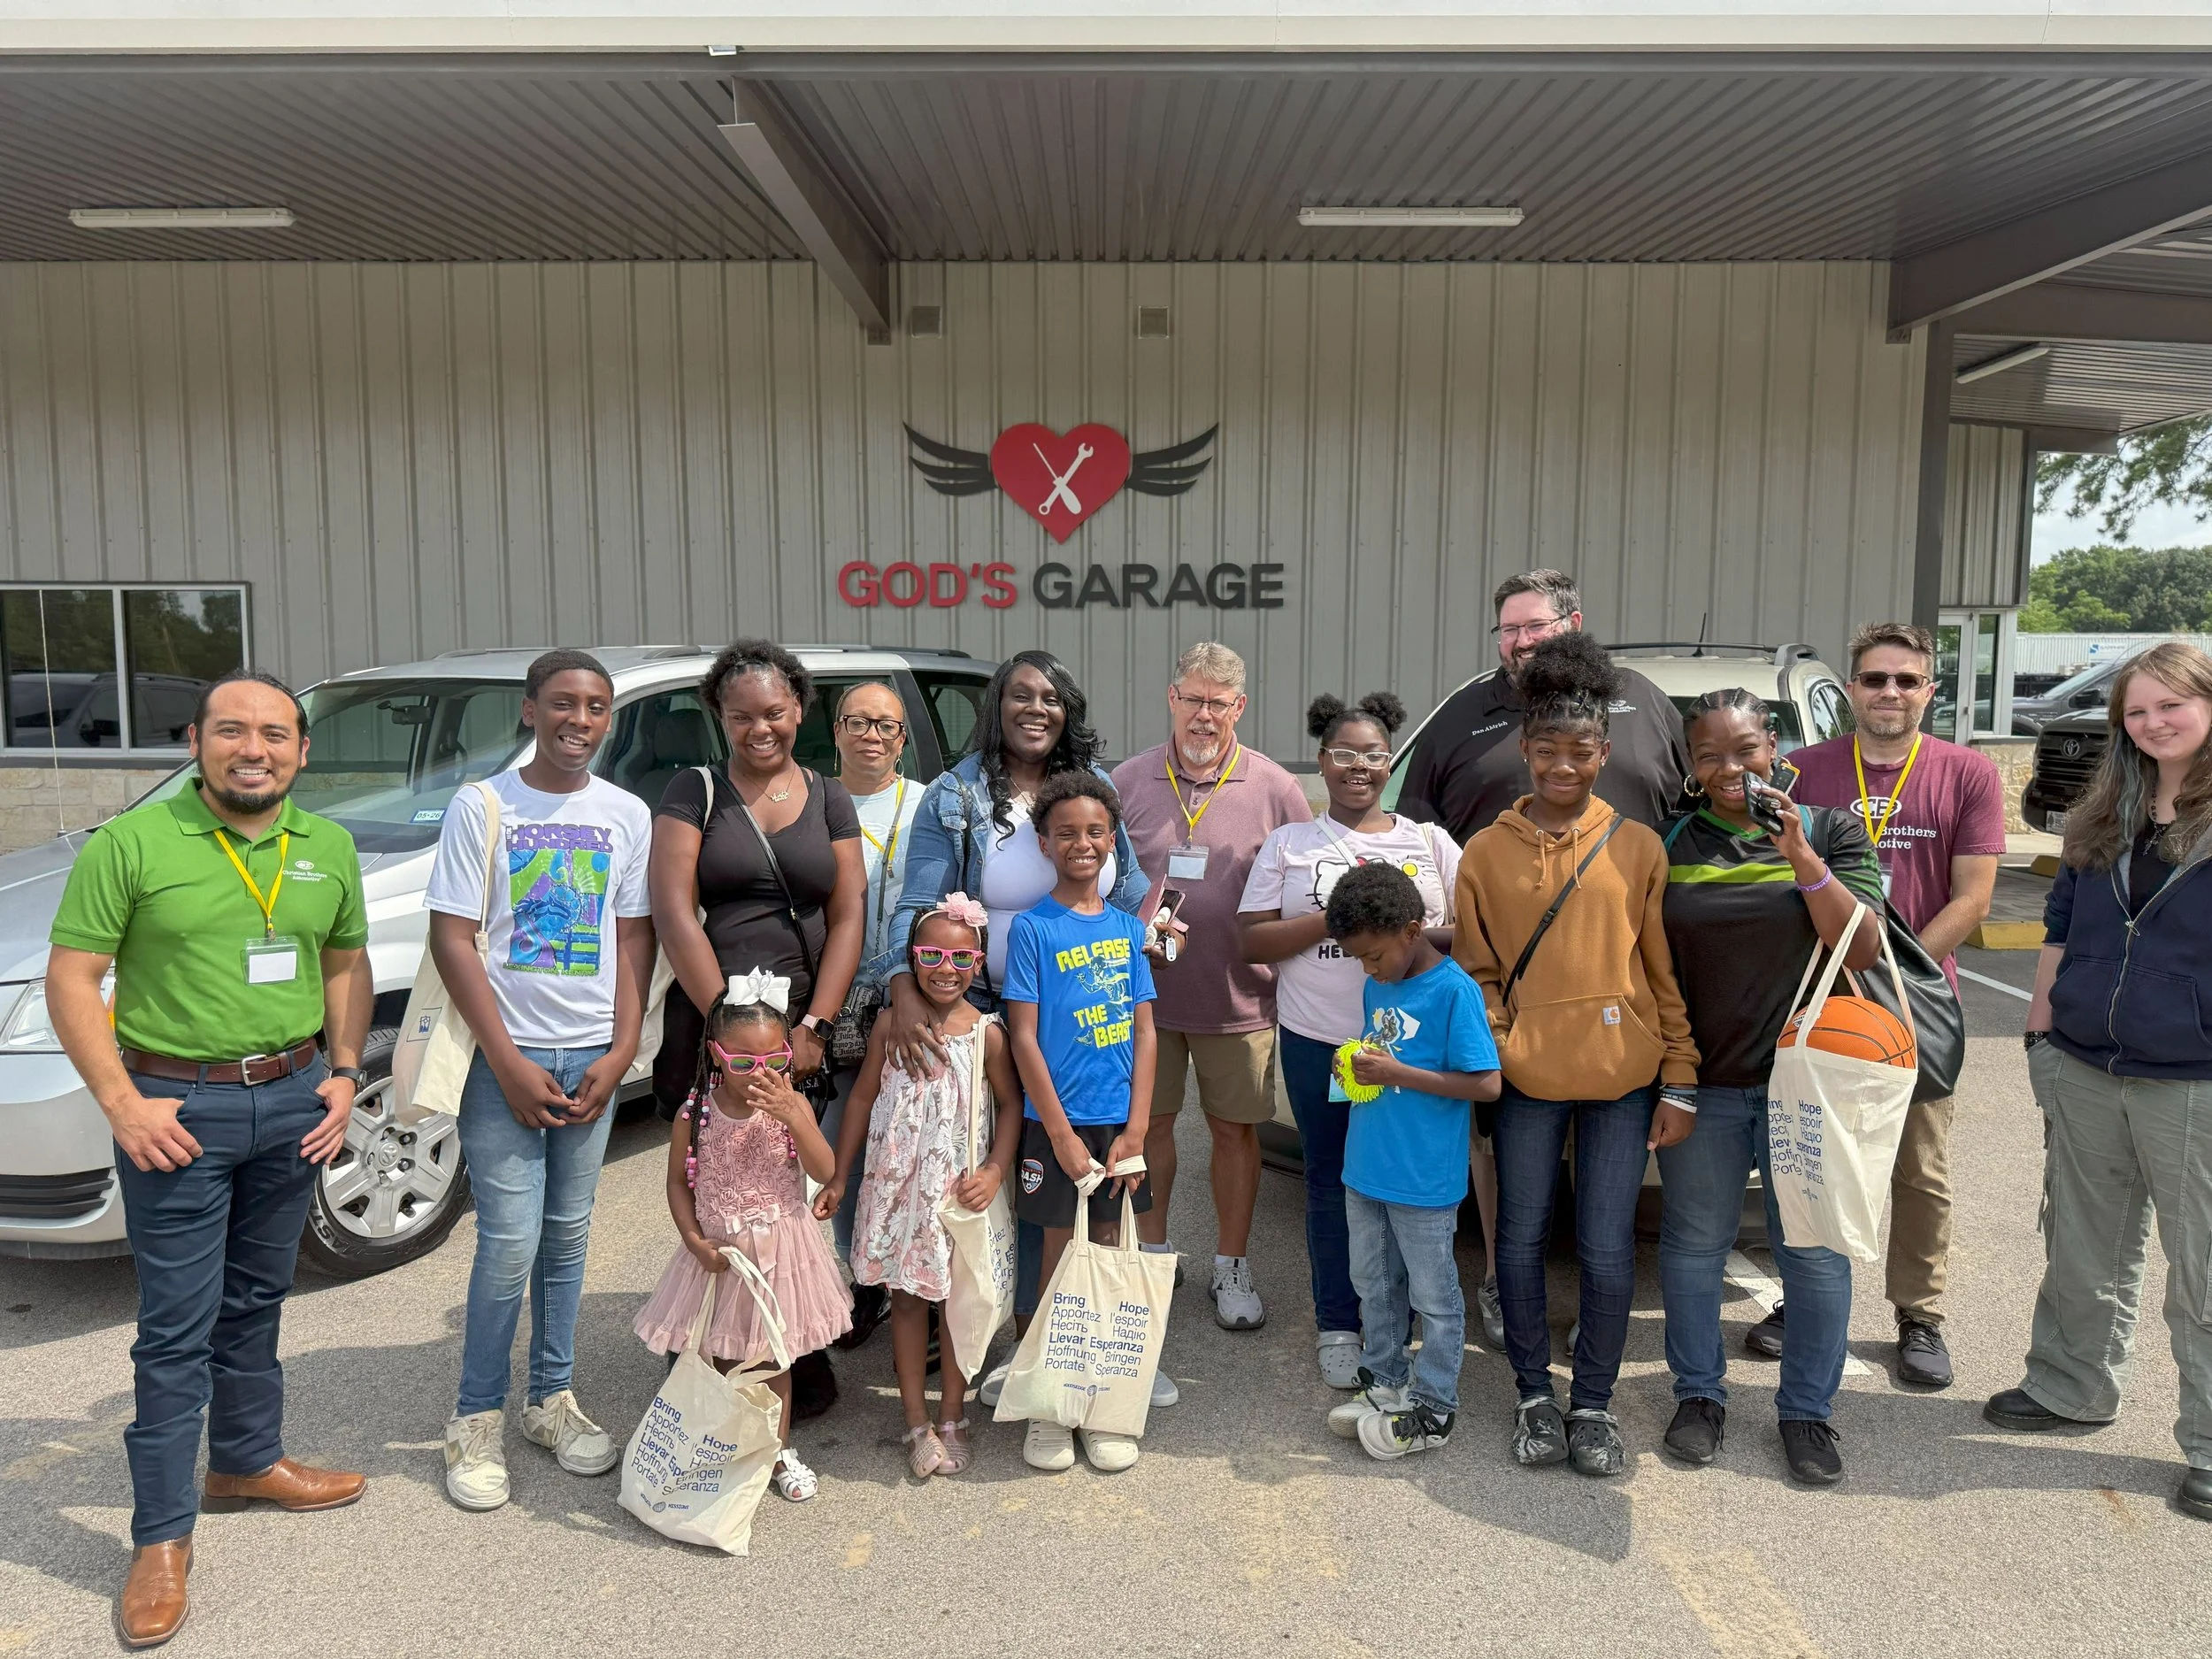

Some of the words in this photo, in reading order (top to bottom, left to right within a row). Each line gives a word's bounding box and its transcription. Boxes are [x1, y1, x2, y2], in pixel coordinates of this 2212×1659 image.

[838, 561, 1018, 608] GOD'S
[1033, 562, 1284, 609] GARAGE
[506, 824, 611, 842] HORSEY
[506, 838, 614, 853] HUNDRED
[1056, 938, 1131, 972] RELEASE
[1317, 944, 1354, 959] HEL
[1073, 1004, 1108, 1028] THE
[1094, 1019, 1132, 1048] BEAST
[1798, 1100, 1822, 1116] Hope
[1051, 1305, 1101, 1323] Apportez
[1054, 1293, 1086, 1308] Bring
[1118, 1301, 1149, 1316] Hope
[1048, 1332, 1086, 1345] Llevar
[1089, 1336, 1144, 1353] Esperanza
[1047, 1345, 1096, 1364] Hoffnung
[1104, 1351, 1141, 1366] Bringen
[1044, 1357, 1086, 1372] Portate
[1094, 1363, 1139, 1378] Speranza
[649, 1409, 689, 1445] Apportez
[654, 1396, 681, 1423] Bring
[703, 1434, 737, 1452] Hope
[641, 1432, 670, 1460] Llevar
[636, 1444, 668, 1484] Hoffnung
